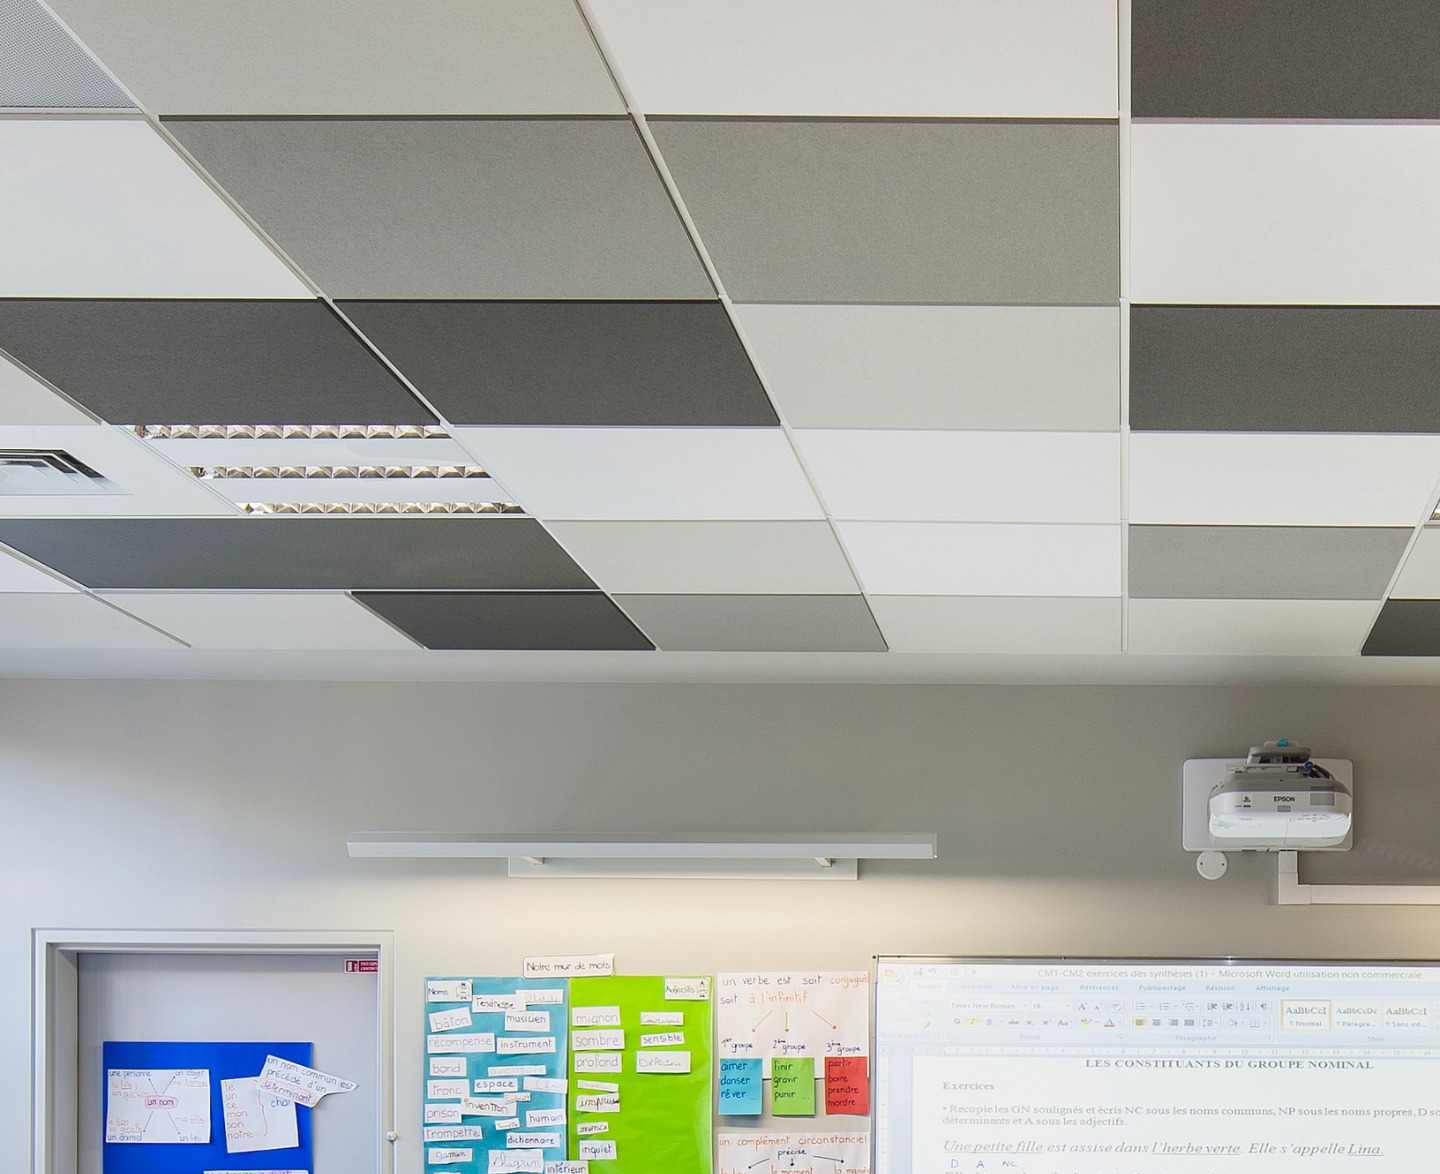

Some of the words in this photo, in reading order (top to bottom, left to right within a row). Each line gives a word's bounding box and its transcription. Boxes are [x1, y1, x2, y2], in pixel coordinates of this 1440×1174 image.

[527, 963, 550, 971] Notre
[575, 962, 585, 970] de
[589, 962, 610, 970] mots
[501, 1039, 551, 1048] instrument
[575, 1032, 620, 1046] sombre
[643, 1034, 681, 1044] sensible
[1086, 1060, 1110, 1068] LES
[1116, 1060, 1220, 1068] CONSTITUANTS
[1225, 1060, 1243, 1068] DU
[1248, 1061, 1304, 1069] GROUPE
[1308, 1061, 1374, 1069] NOMINAL
[476, 1080, 514, 1088] espace
[943, 1082, 994, 1090] Exercices
[507, 1135, 555, 1145] dictionnaire
[737, 1136, 790, 1151] complément
[799, 1135, 867, 1145] circonstanciel
[944, 1141, 972, 1152] Une
[974, 1141, 1013, 1153] petite
[1015, 1141, 1043, 1153] fille
[1047, 1144, 1067, 1153] est
[1070, 1144, 1113, 1153] assise
[1115, 1142, 1148, 1153] dans
[1152, 1143, 1203, 1153] l'herbe
[1249, 1143, 1276, 1154] Elle
[1281, 1144, 1345, 1156] s'appelle
[1348, 1144, 1384, 1155] Lina.
[547, 1163, 586, 1174] intérieur
